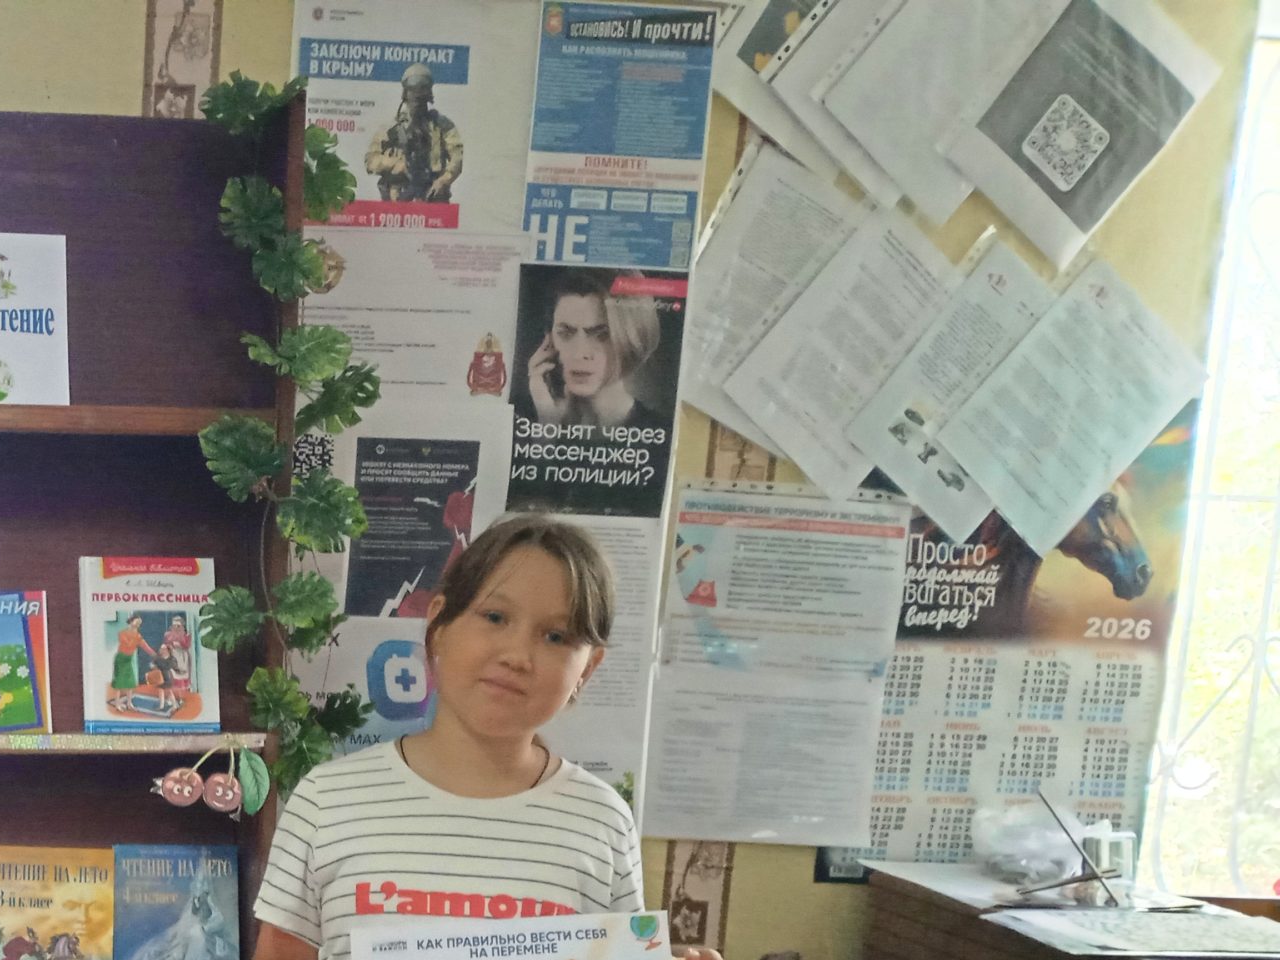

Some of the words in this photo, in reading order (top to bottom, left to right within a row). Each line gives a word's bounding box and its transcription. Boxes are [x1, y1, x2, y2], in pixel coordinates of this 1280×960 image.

[570, 21, 628, 37] ОСТАНОВИСЬ!
[632, 19, 642, 38] И
[644, 15, 712, 44] прочти!
[310, 43, 381, 61] ЗАКЛЮЧИ
[384, 45, 455, 63] КОНТРАКТ
[309, 60, 319, 74] В
[322, 61, 375, 77] КРЫМУ
[584, 156, 649, 170] ПОМНИТЕ!
[528, 213, 590, 262] НЕ
[516, 417, 596, 440] Звонят
[602, 427, 665, 447] через
[514, 443, 650, 468] мессенджер
[511, 465, 538, 481] из
[545, 466, 655, 488] полиции?
[907, 533, 987, 568] Просто
[91, 592, 209, 604] ПЕРВОКЛАССНИЦА
[1084, 617, 1152, 641] 2026
[349, 733, 383, 745] MAX
[417, 939, 443, 951] КАК
[446, 933, 526, 949] ПРАВИЛЬНО
[530, 931, 572, 944] ВЕСТИ
[575, 928, 607, 940] СЕБЯ
[470, 946, 488, 959] НА
[492, 943, 558, 957] ПЕРЕМЕНЕ
